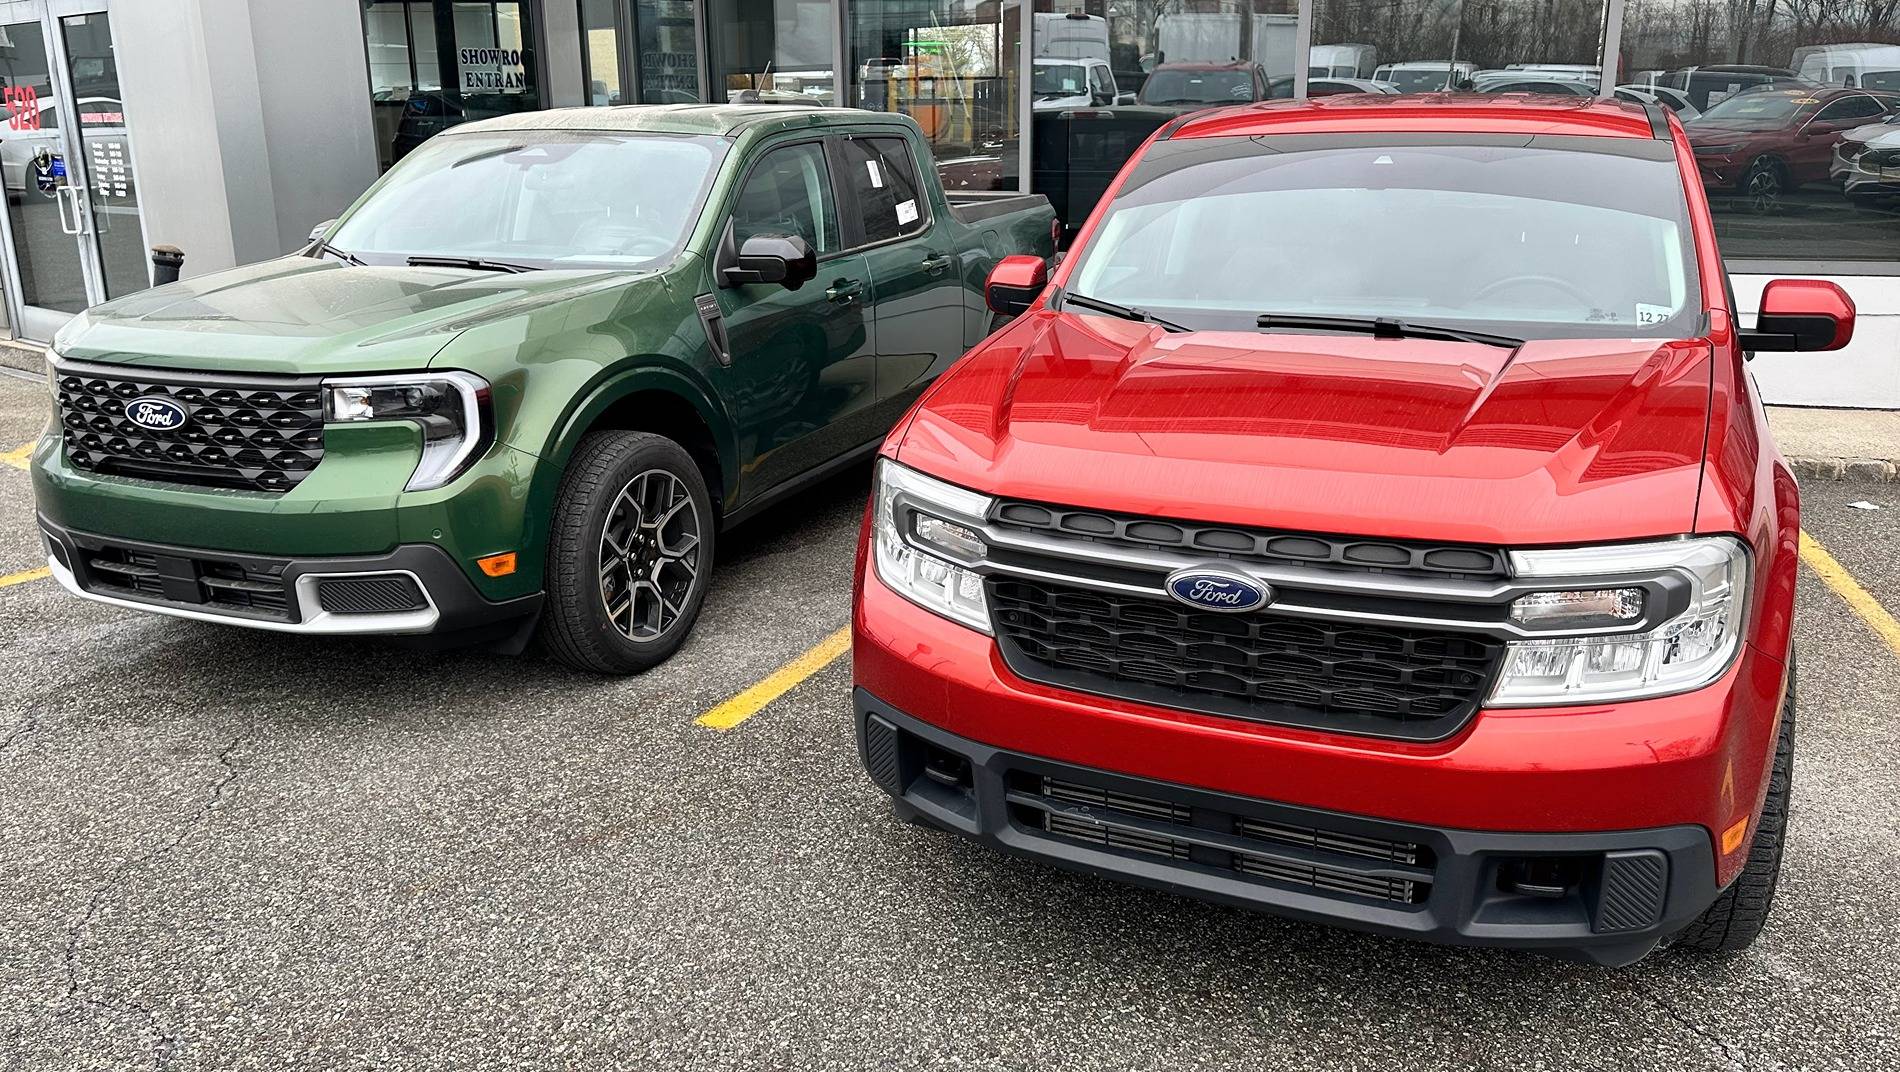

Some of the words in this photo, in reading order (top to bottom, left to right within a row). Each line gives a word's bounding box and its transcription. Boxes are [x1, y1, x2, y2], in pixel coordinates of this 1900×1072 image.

[4, 86, 40, 130] 520
[1640, 311, 1653, 323] 12
[136, 403, 173, 426] Ford
[1189, 580, 1242, 605] Ford
